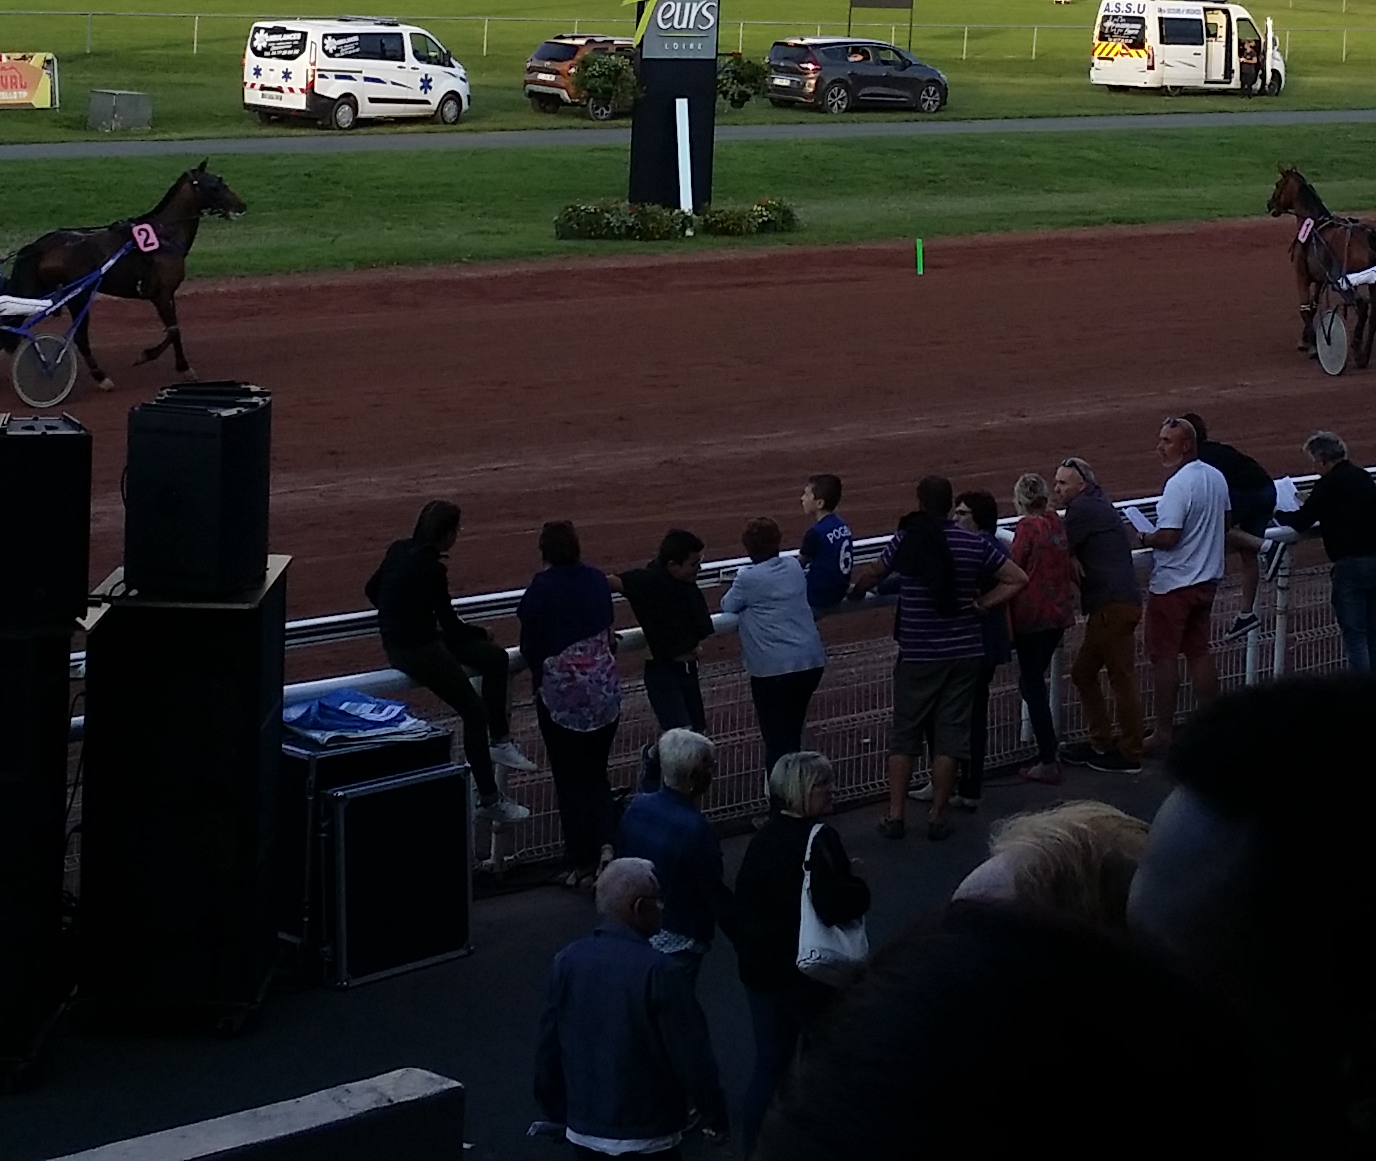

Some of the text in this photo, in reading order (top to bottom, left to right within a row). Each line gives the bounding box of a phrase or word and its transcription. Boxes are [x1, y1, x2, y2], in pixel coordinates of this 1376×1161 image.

[664, 42, 703, 51] LOIRE
[137, 228, 155, 248] 2
[839, 539, 852, 575] 6
